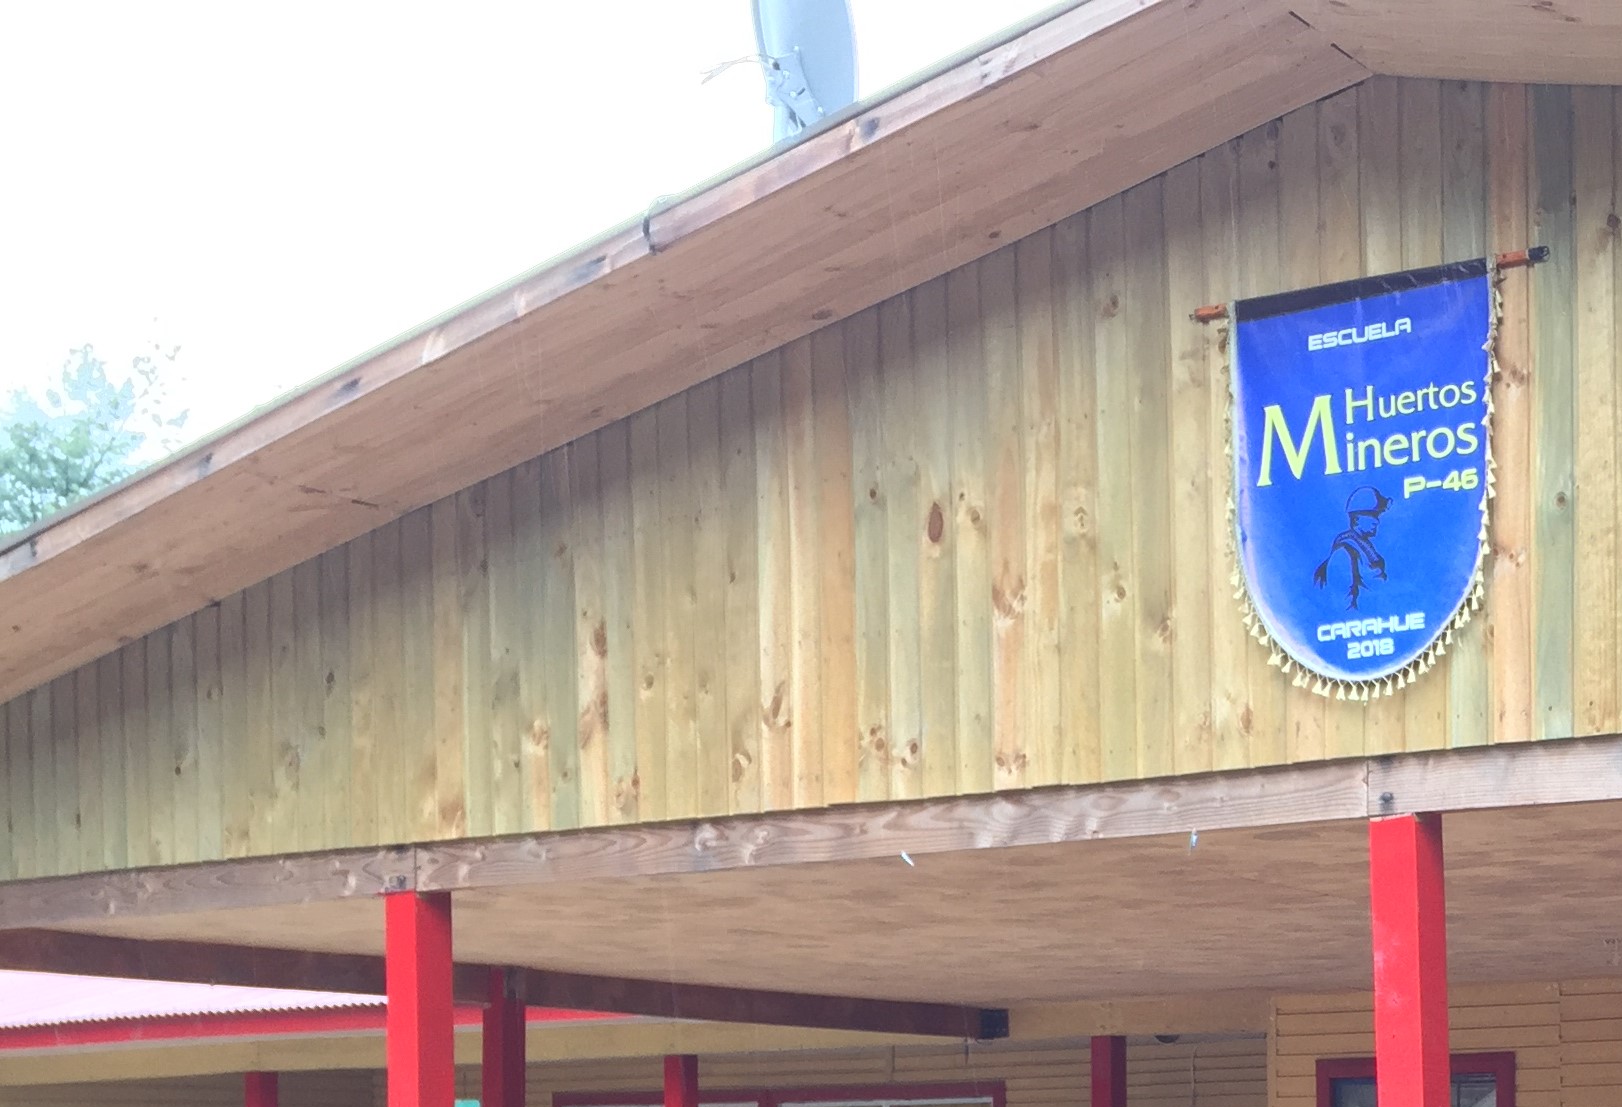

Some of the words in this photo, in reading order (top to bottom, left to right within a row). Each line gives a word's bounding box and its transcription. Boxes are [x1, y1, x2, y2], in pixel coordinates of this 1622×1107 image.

[1308, 317, 1411, 351] ESCUELA
[1345, 380, 1477, 424] Huertos
[1257, 395, 1478, 487] Mineros
[1404, 469, 1478, 499] P-46
[1317, 612, 1425, 641] CARAHUE
[1347, 639, 1394, 659] 2018
